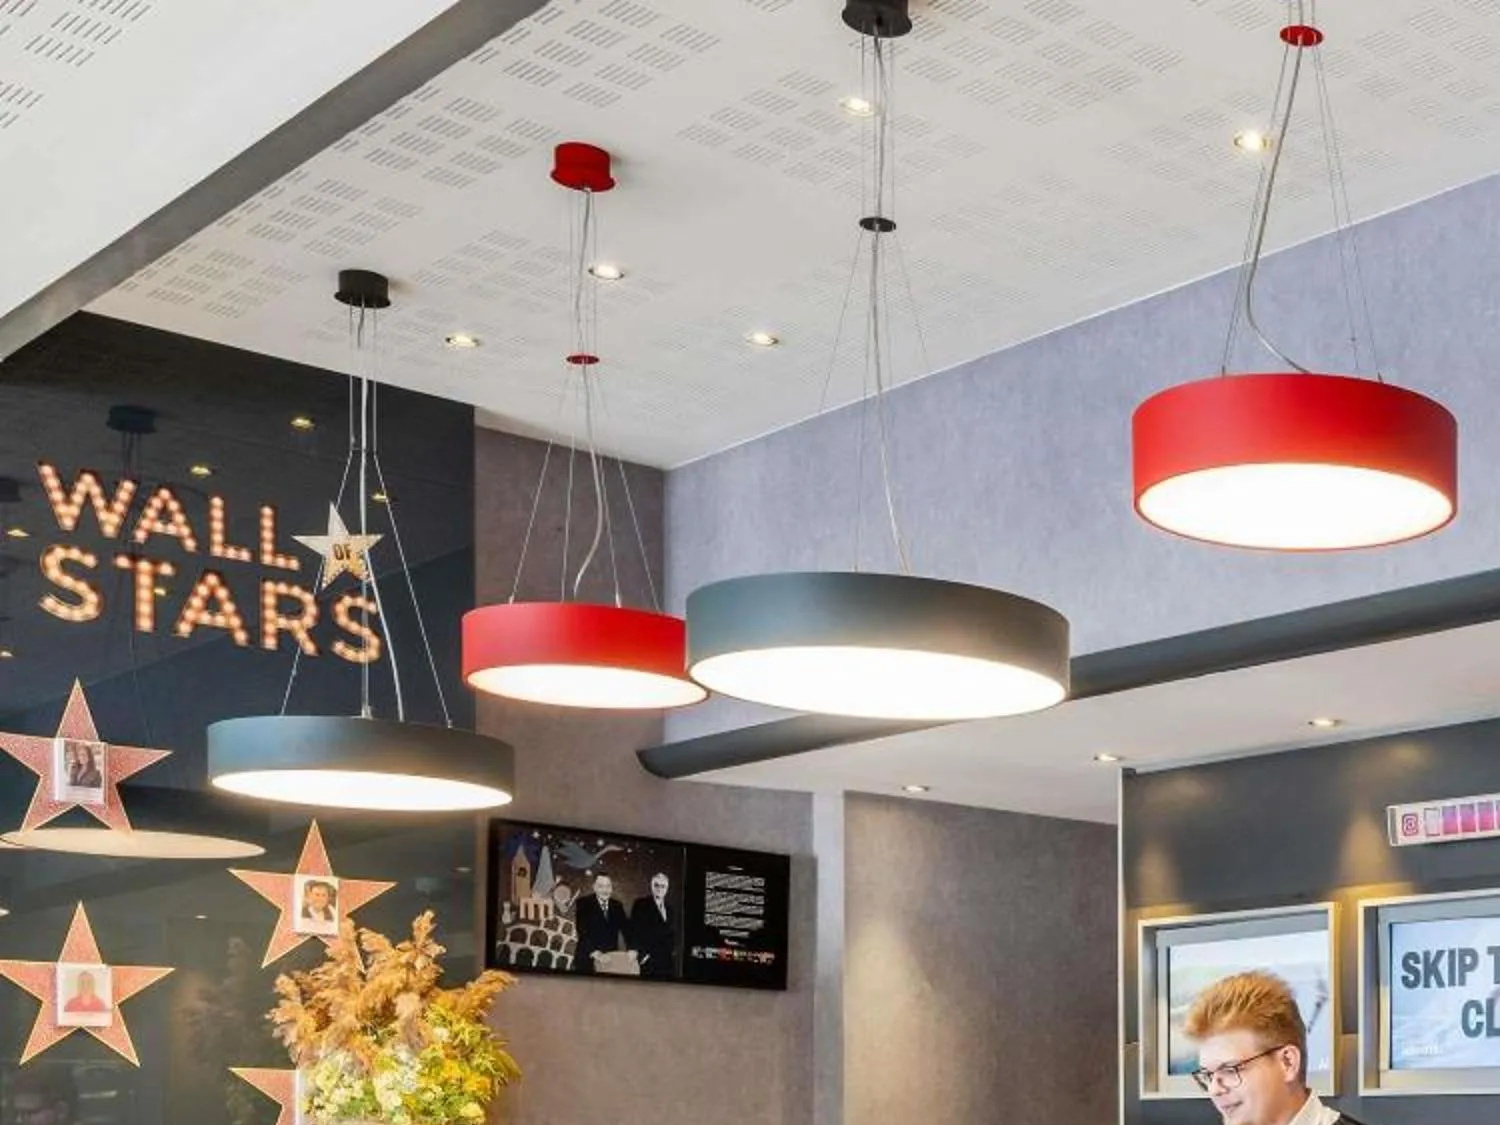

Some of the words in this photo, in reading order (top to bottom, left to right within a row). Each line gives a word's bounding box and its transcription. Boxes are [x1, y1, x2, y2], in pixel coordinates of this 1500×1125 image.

[37, 460, 299, 571] WALL
[333, 543, 351, 560] OF
[39, 544, 384, 664] STARS
[1401, 948, 1479, 989] SKIP
